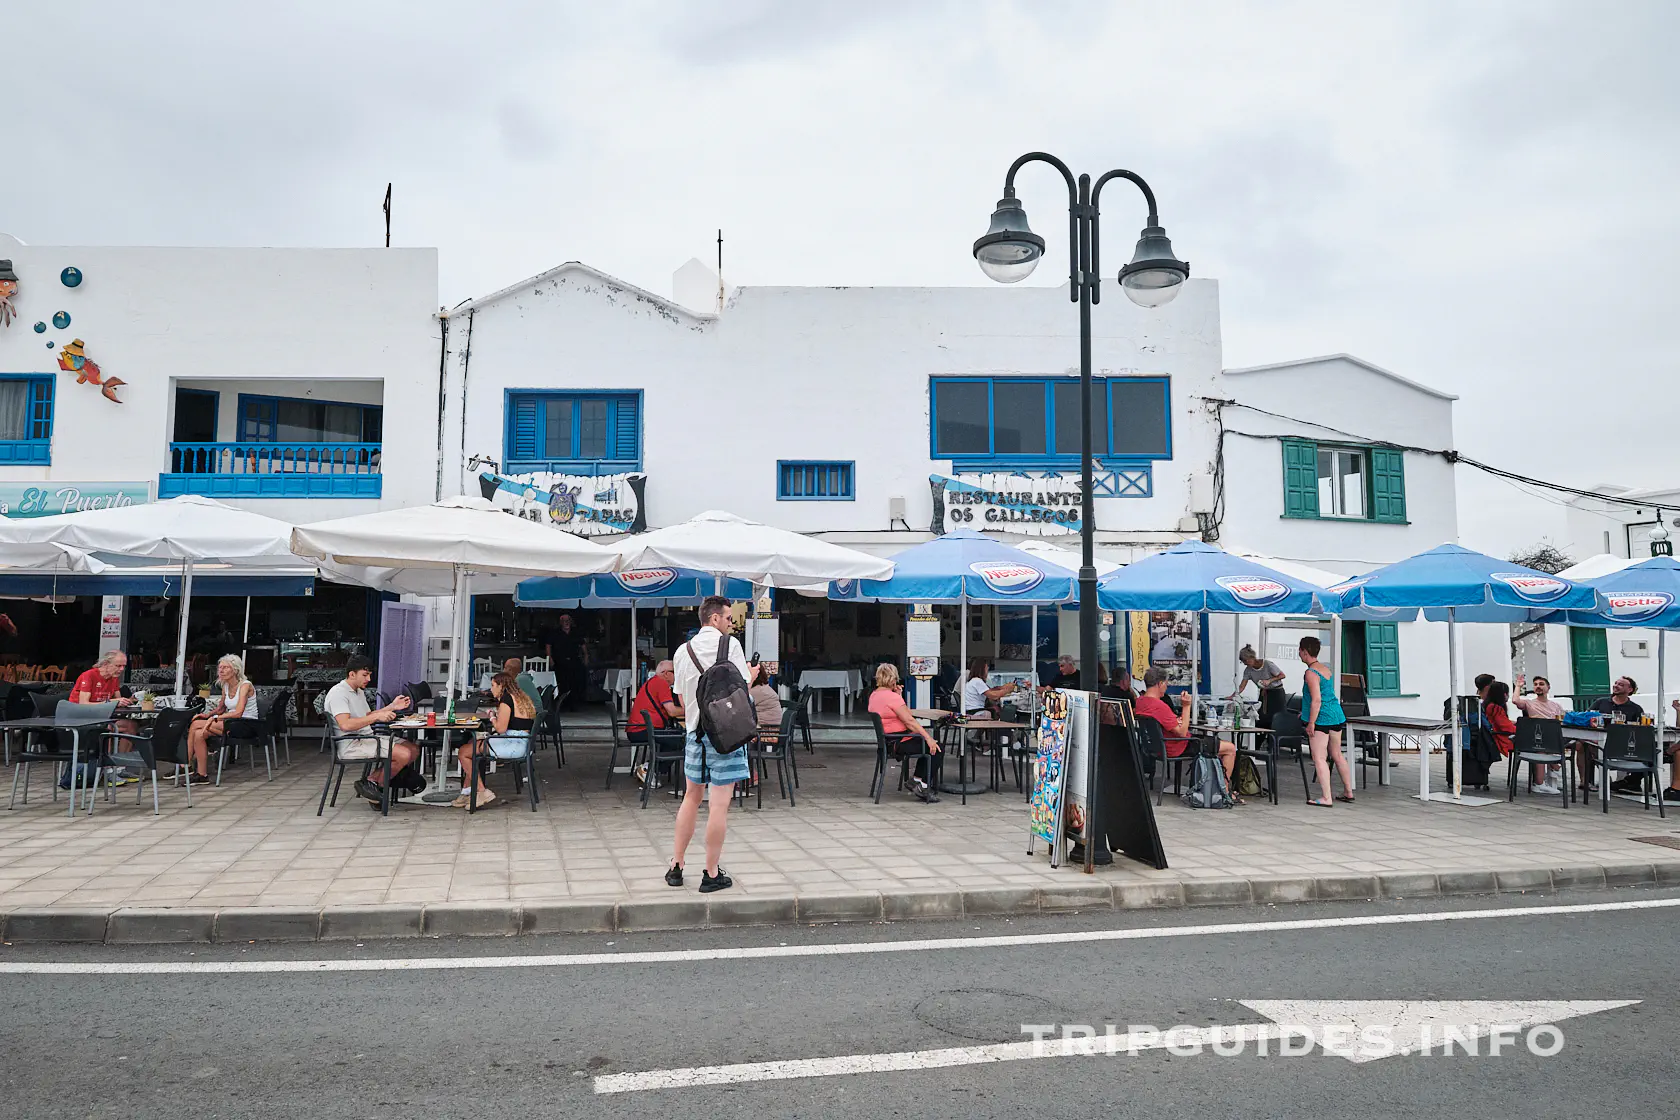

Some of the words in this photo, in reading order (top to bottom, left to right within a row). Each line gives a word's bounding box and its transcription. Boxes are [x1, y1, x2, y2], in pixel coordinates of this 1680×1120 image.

[18, 487, 48, 514] El
[55, 487, 133, 514] Puerto
[949, 491, 1083, 506] RESTAURANTE
[502, 508, 542, 522] AR
[950, 507, 974, 523] OS
[985, 508, 1079, 523] GALLEGOS
